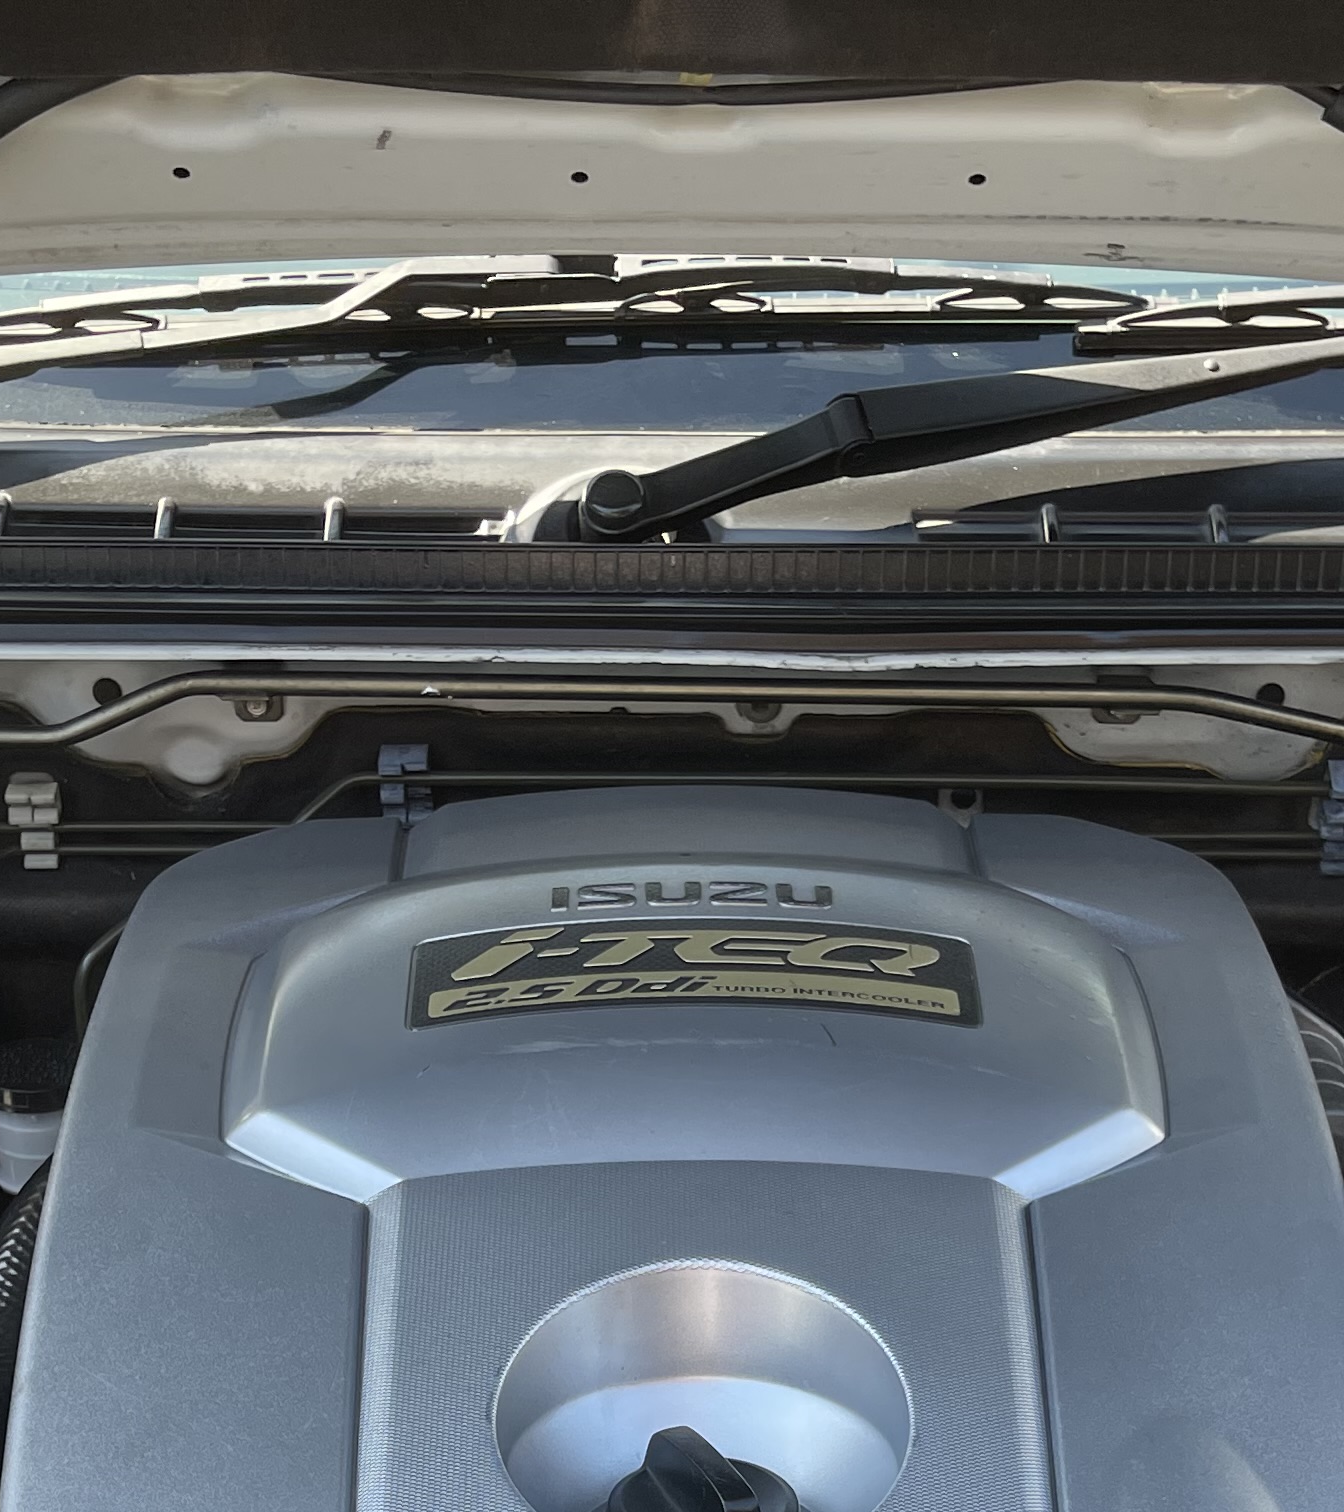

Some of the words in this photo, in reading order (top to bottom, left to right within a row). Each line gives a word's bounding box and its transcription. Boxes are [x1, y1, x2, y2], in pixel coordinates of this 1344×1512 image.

[550, 880, 834, 912] ISUZU
[713, 984, 787, 996] TURBO
[792, 986, 947, 1010] INTERCOOLER
